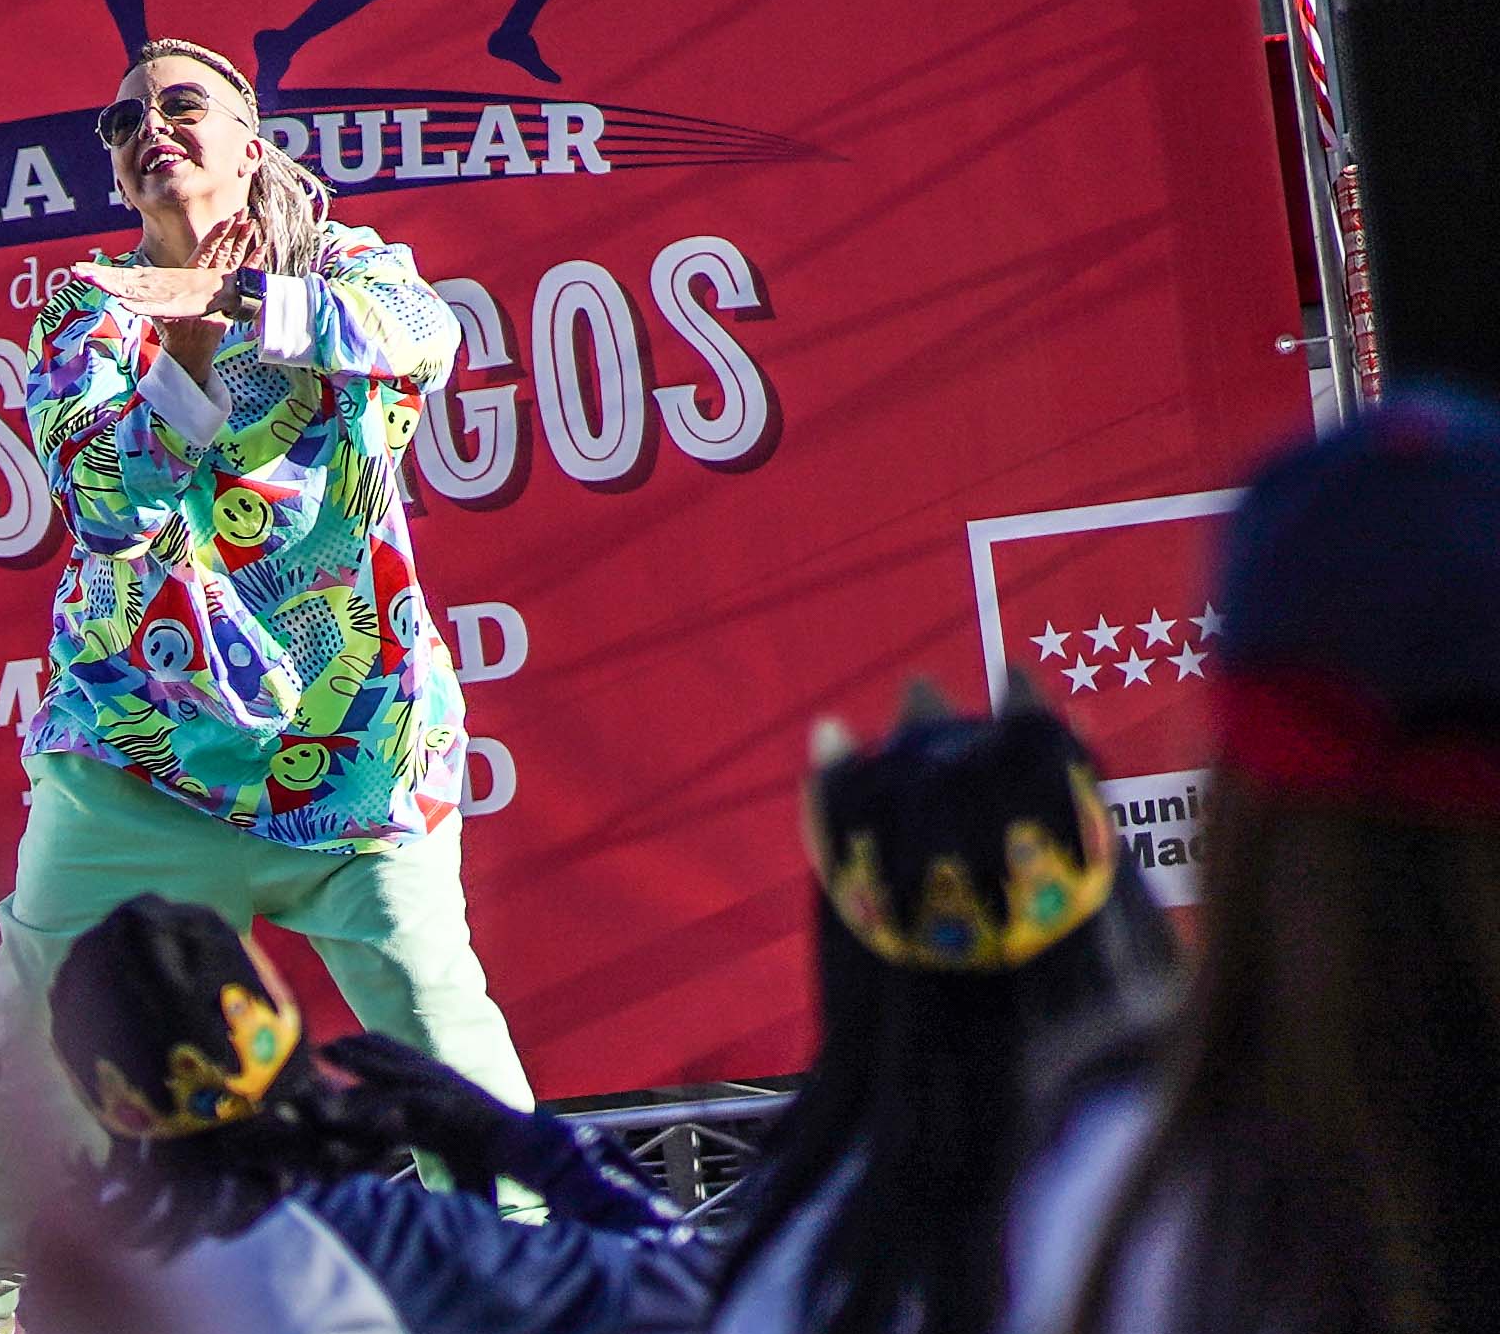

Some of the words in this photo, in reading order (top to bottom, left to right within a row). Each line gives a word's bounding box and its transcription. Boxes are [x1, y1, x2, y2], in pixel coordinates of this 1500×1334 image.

[108, 102, 612, 206] PULAR
[9, 255, 72, 310] de
[398, 235, 768, 503] GOS
